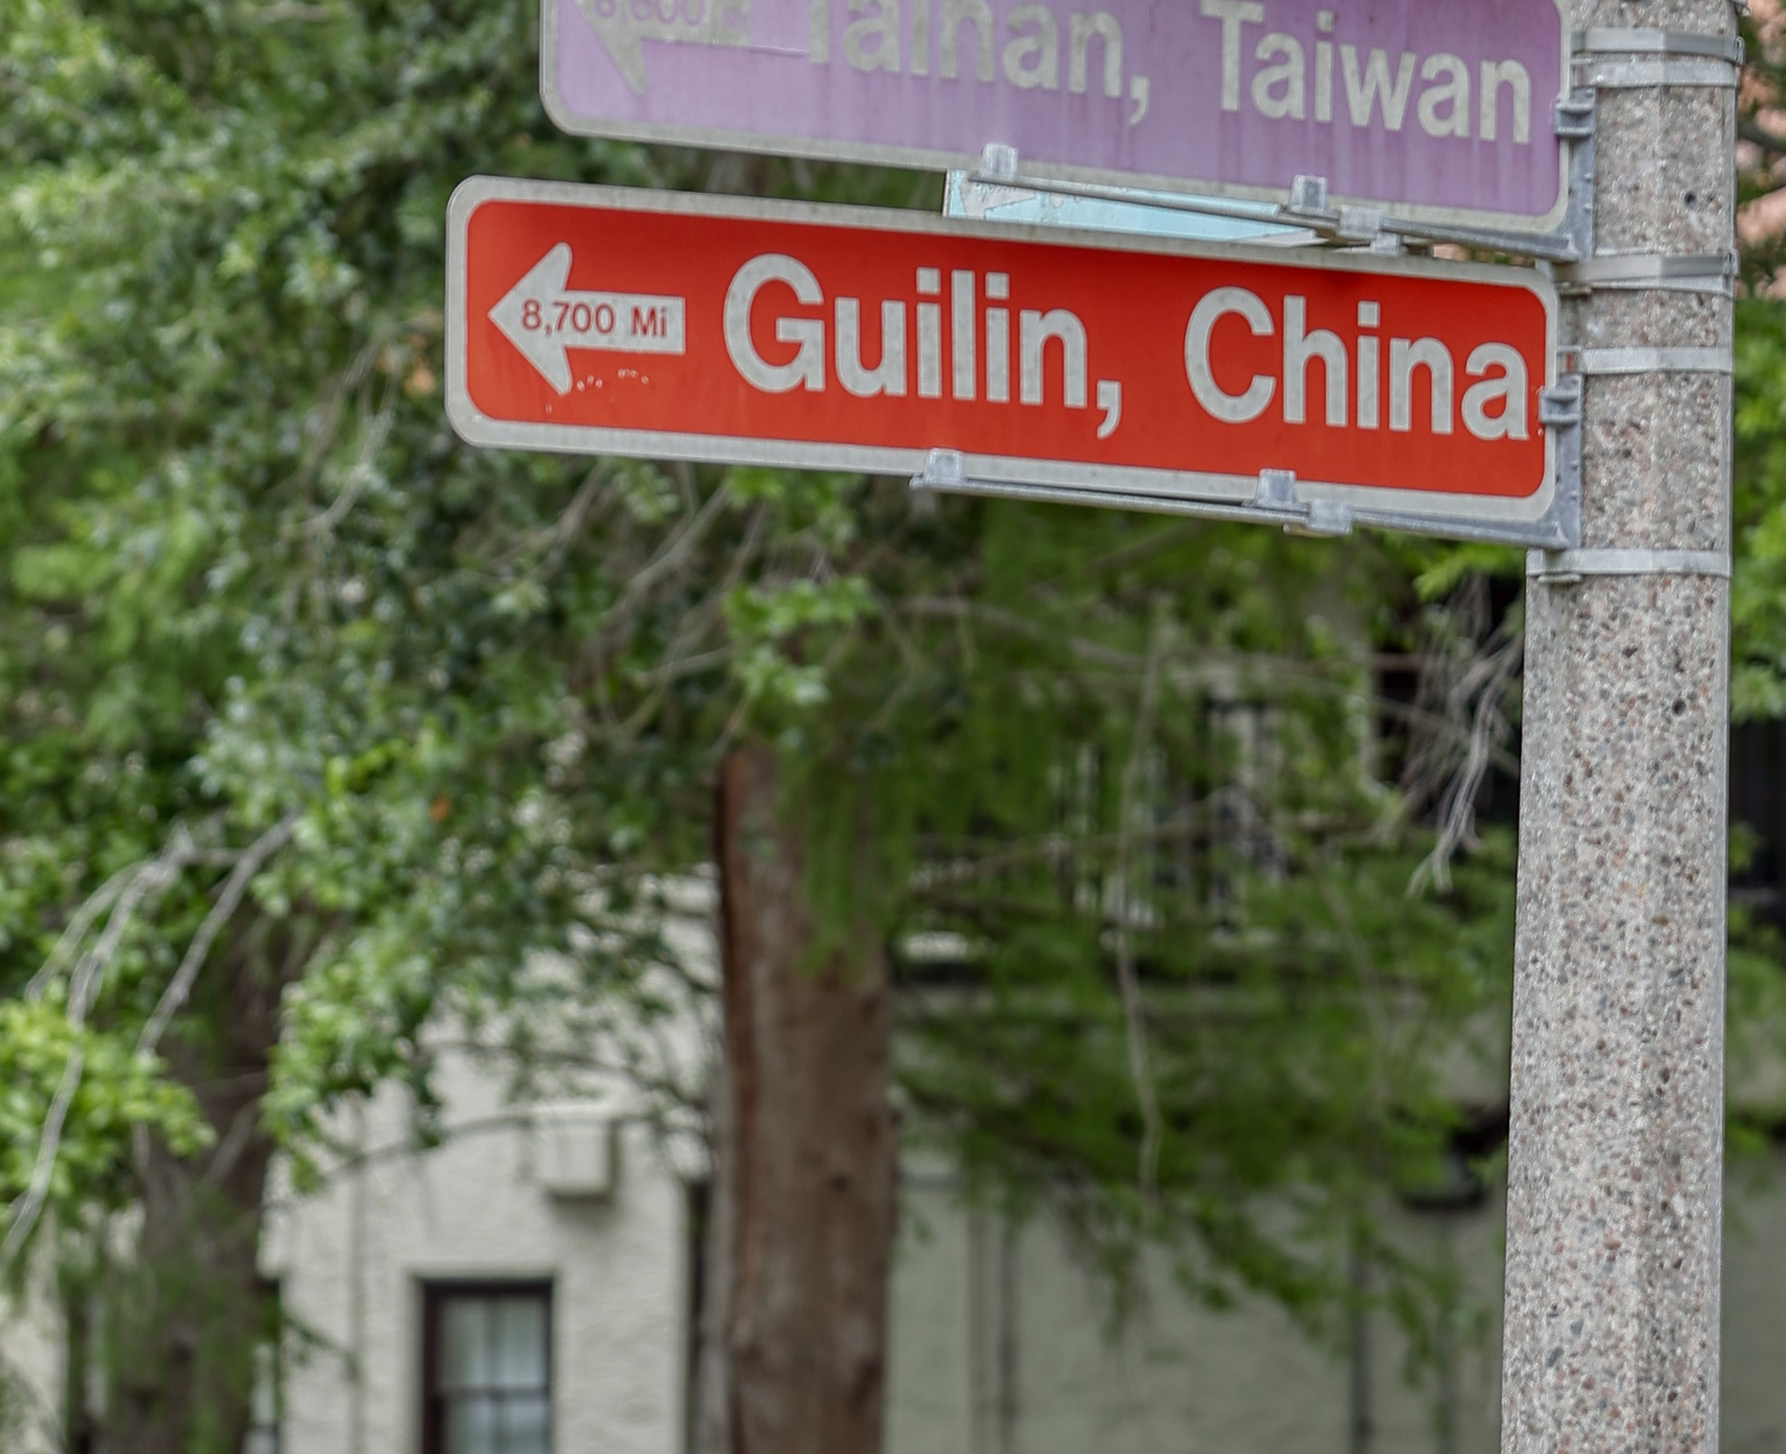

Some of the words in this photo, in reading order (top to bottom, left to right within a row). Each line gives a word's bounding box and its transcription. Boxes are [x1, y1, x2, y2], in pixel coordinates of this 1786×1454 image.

[520, 297, 616, 337] 8,700
[630, 305, 667, 338] Mi
[723, 252, 1121, 439] Guilin,
[1184, 286, 1529, 441] China
